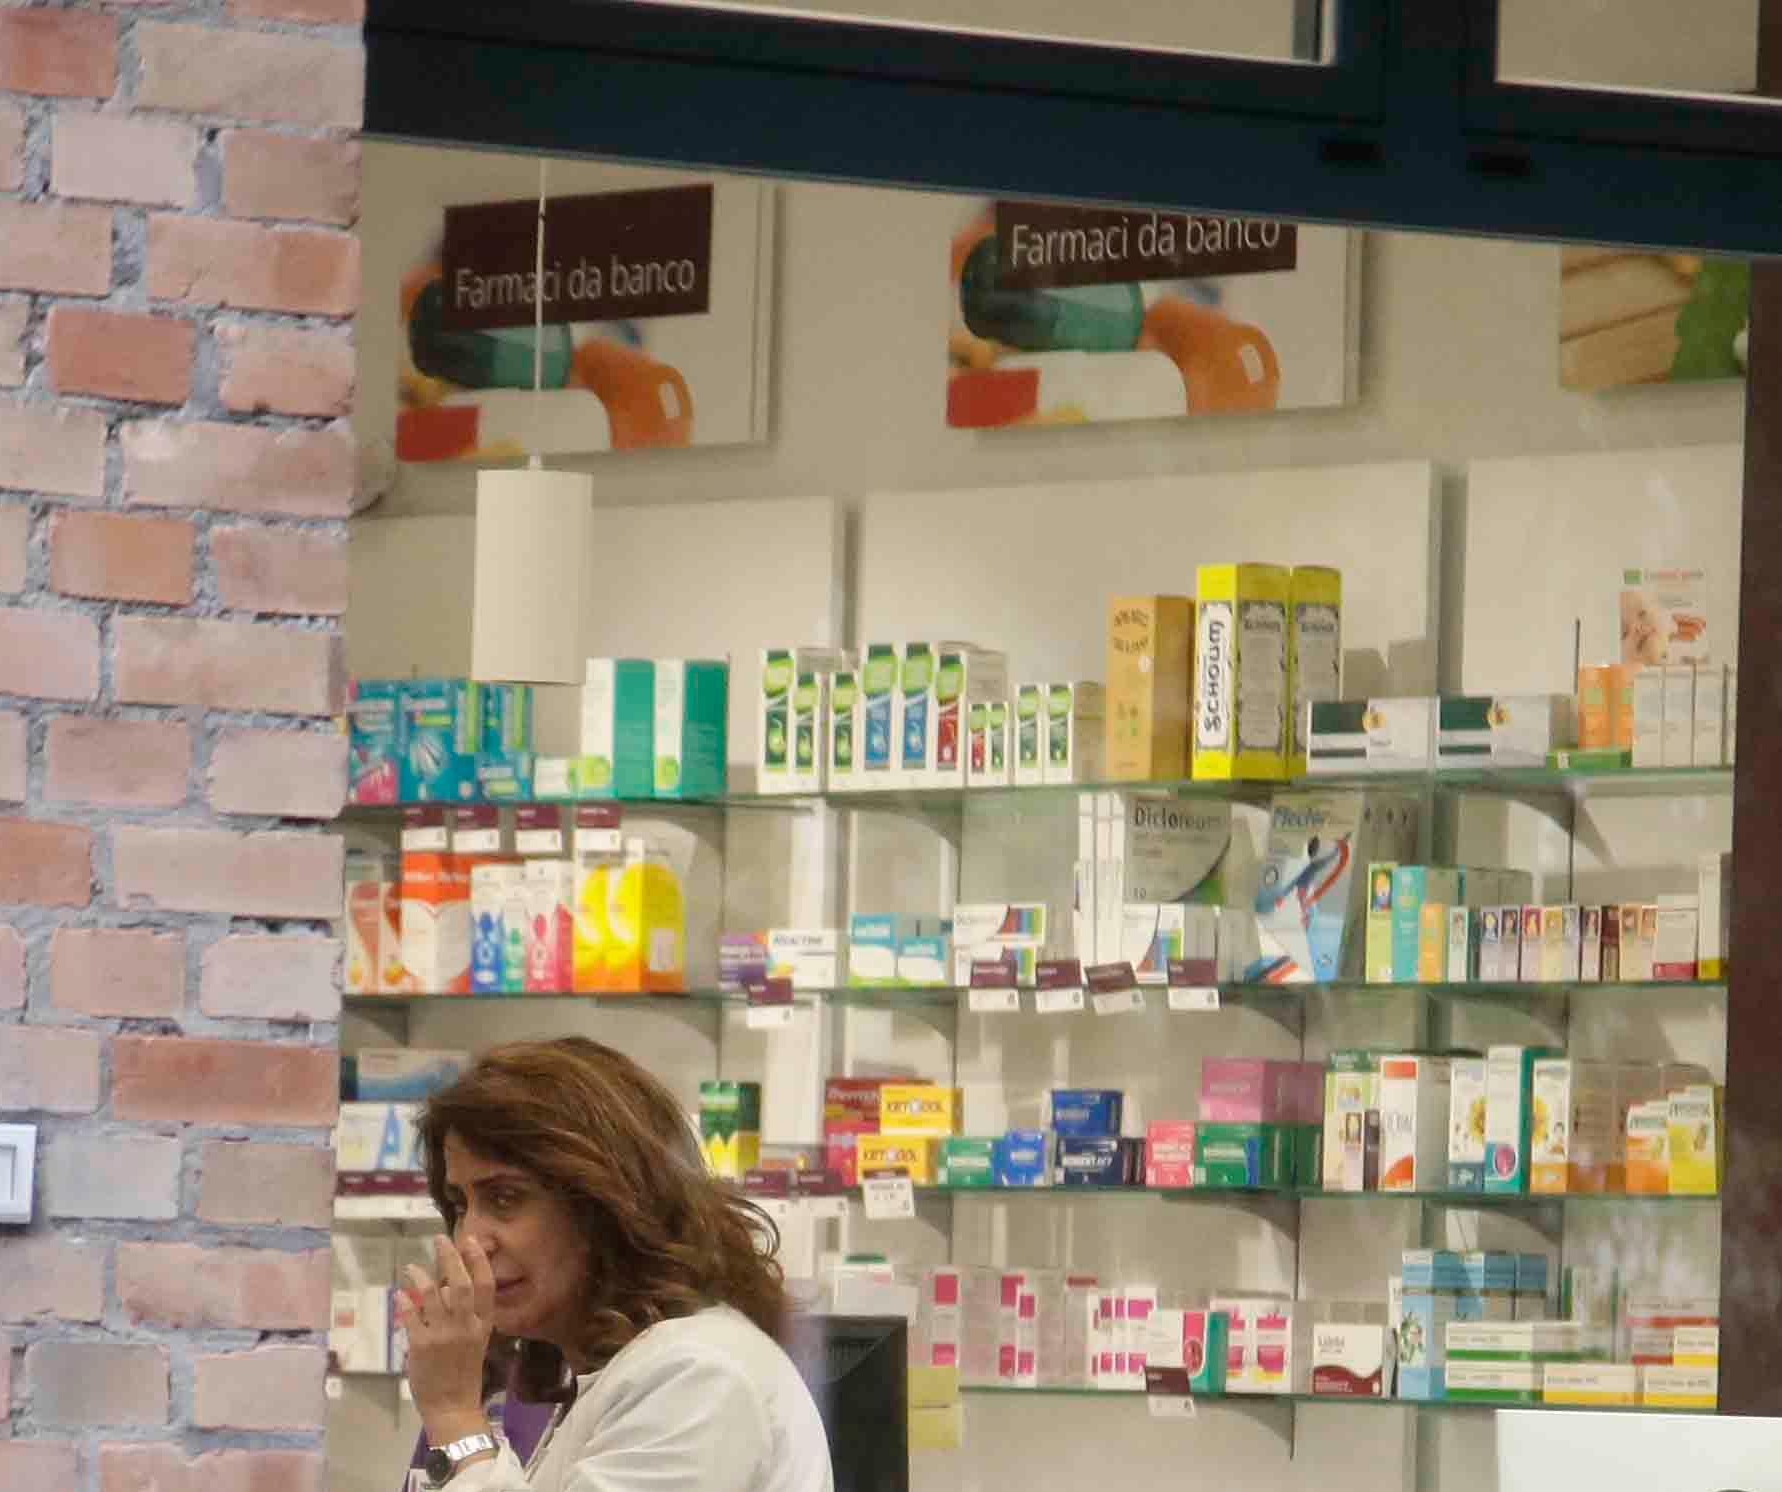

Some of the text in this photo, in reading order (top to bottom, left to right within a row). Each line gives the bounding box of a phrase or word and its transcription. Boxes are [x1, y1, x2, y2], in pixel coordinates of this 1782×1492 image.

[1011, 213, 1281, 267] Farmaci da banco
[455, 253, 696, 310] Farmaci da banco
[1202, 619, 1226, 732] SCHOUM
